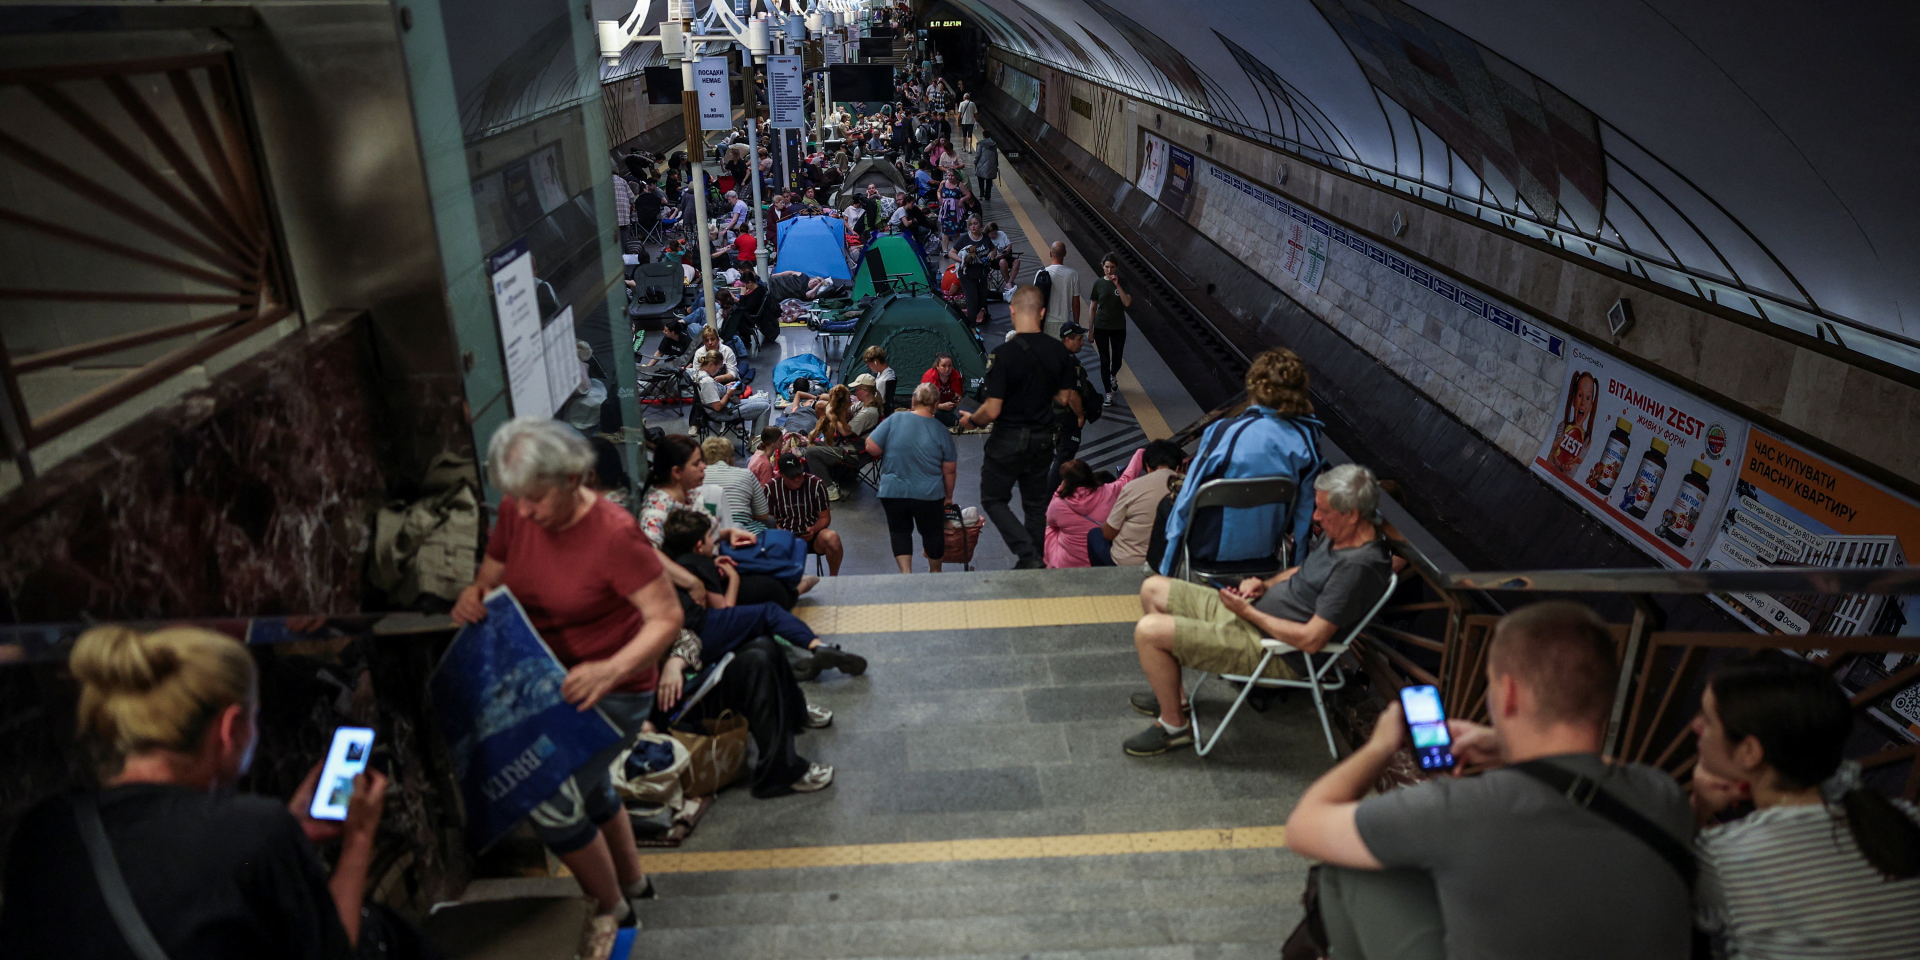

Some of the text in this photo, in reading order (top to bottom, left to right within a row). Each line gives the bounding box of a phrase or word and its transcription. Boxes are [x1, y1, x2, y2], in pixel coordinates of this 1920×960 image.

[1608, 378, 1705, 440] ВІТАМІНИ ZEST
[1560, 433, 1583, 457] ZEST
[1636, 415, 1657, 432] ЖИВИ
[1657, 425, 1663, 435] У
[1664, 429, 1687, 448] ФОРМІ
[1641, 469, 1658, 484] OMEGA
[1754, 440, 1837, 492] ЧАС КУПУВАТИ
[1750, 458, 1857, 522] ВЛАСНУ КВАРТИРУ
[1737, 513, 1800, 555] Малоповерхова забудова
[1742, 498, 1766, 516] Квартири
[1773, 515, 1787, 528] 28,34
[1802, 532, 1816, 545] 80,12
[1731, 528, 1748, 544] Басейн
[1751, 542, 1775, 559] спортзал
[1734, 550, 1742, 560] від
[1742, 556, 1758, 569] метро
[1783, 616, 1801, 632] Оселя
[481, 748, 542, 801] BRITA
